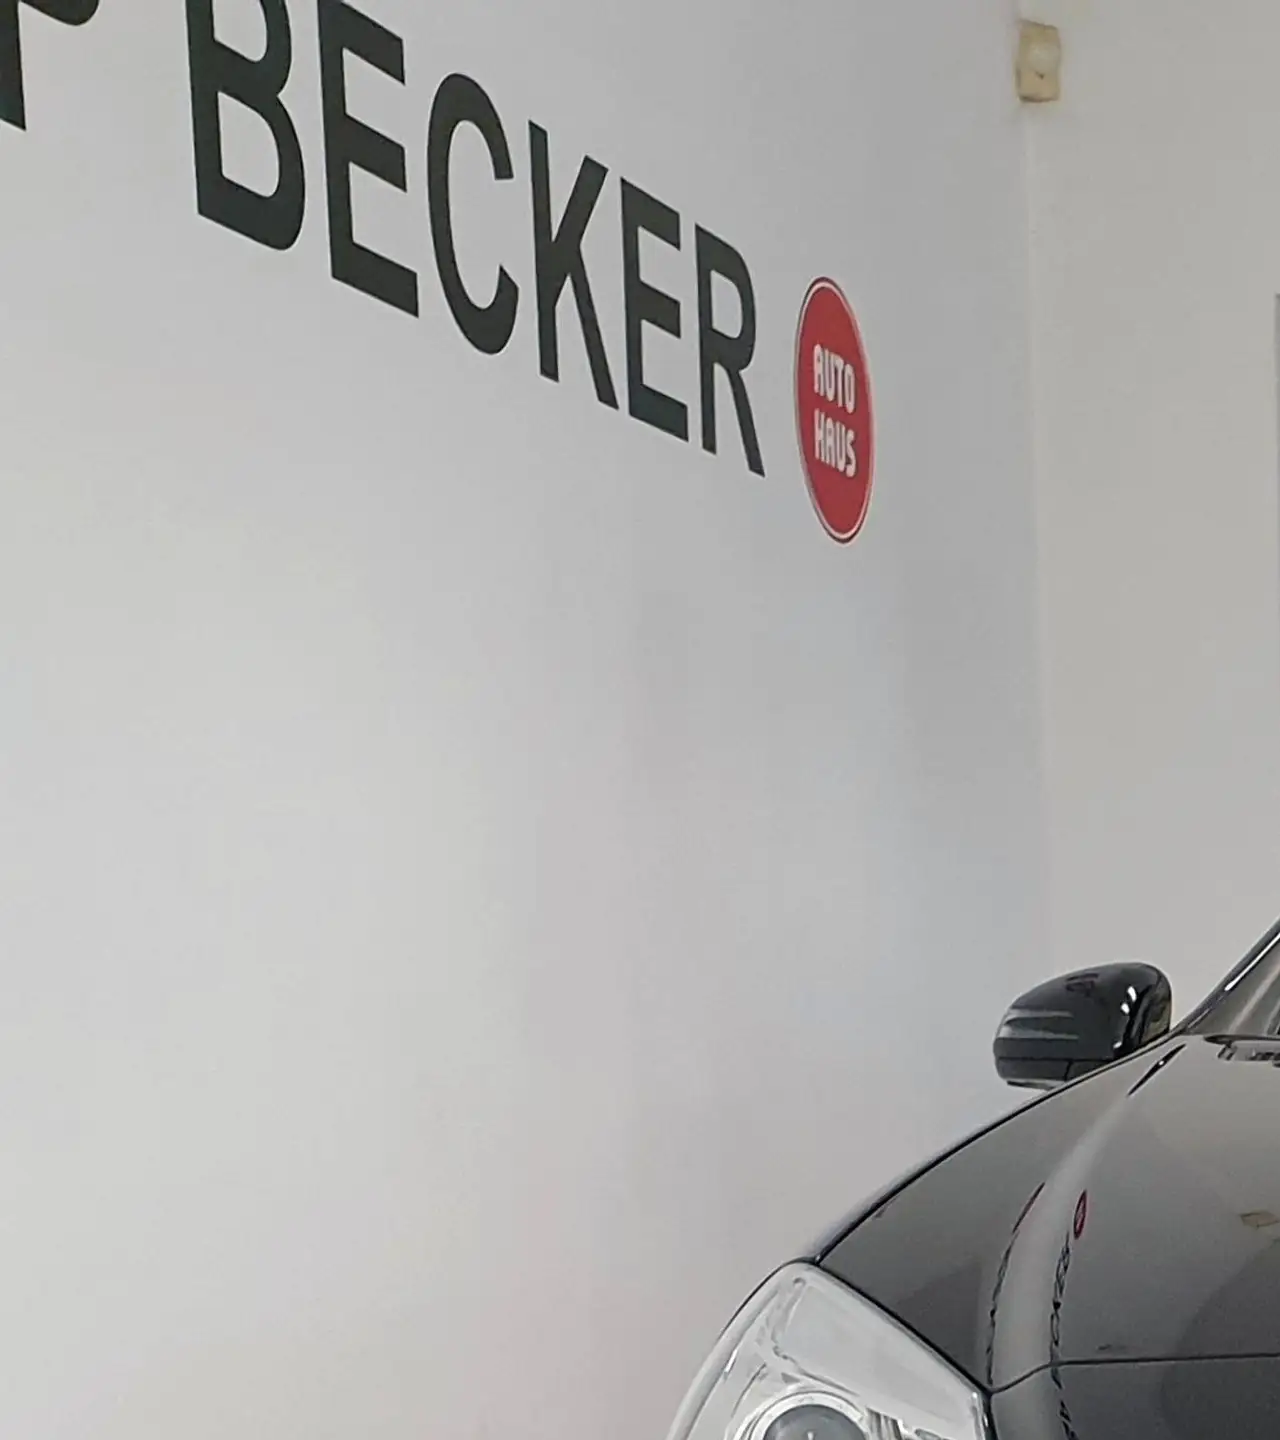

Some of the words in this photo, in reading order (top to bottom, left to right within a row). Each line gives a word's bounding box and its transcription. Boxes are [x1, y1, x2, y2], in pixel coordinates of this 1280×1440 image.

[186, 0, 764, 477] BECKER
[814, 344, 856, 414] AUTO
[814, 407, 857, 478] HAUS
